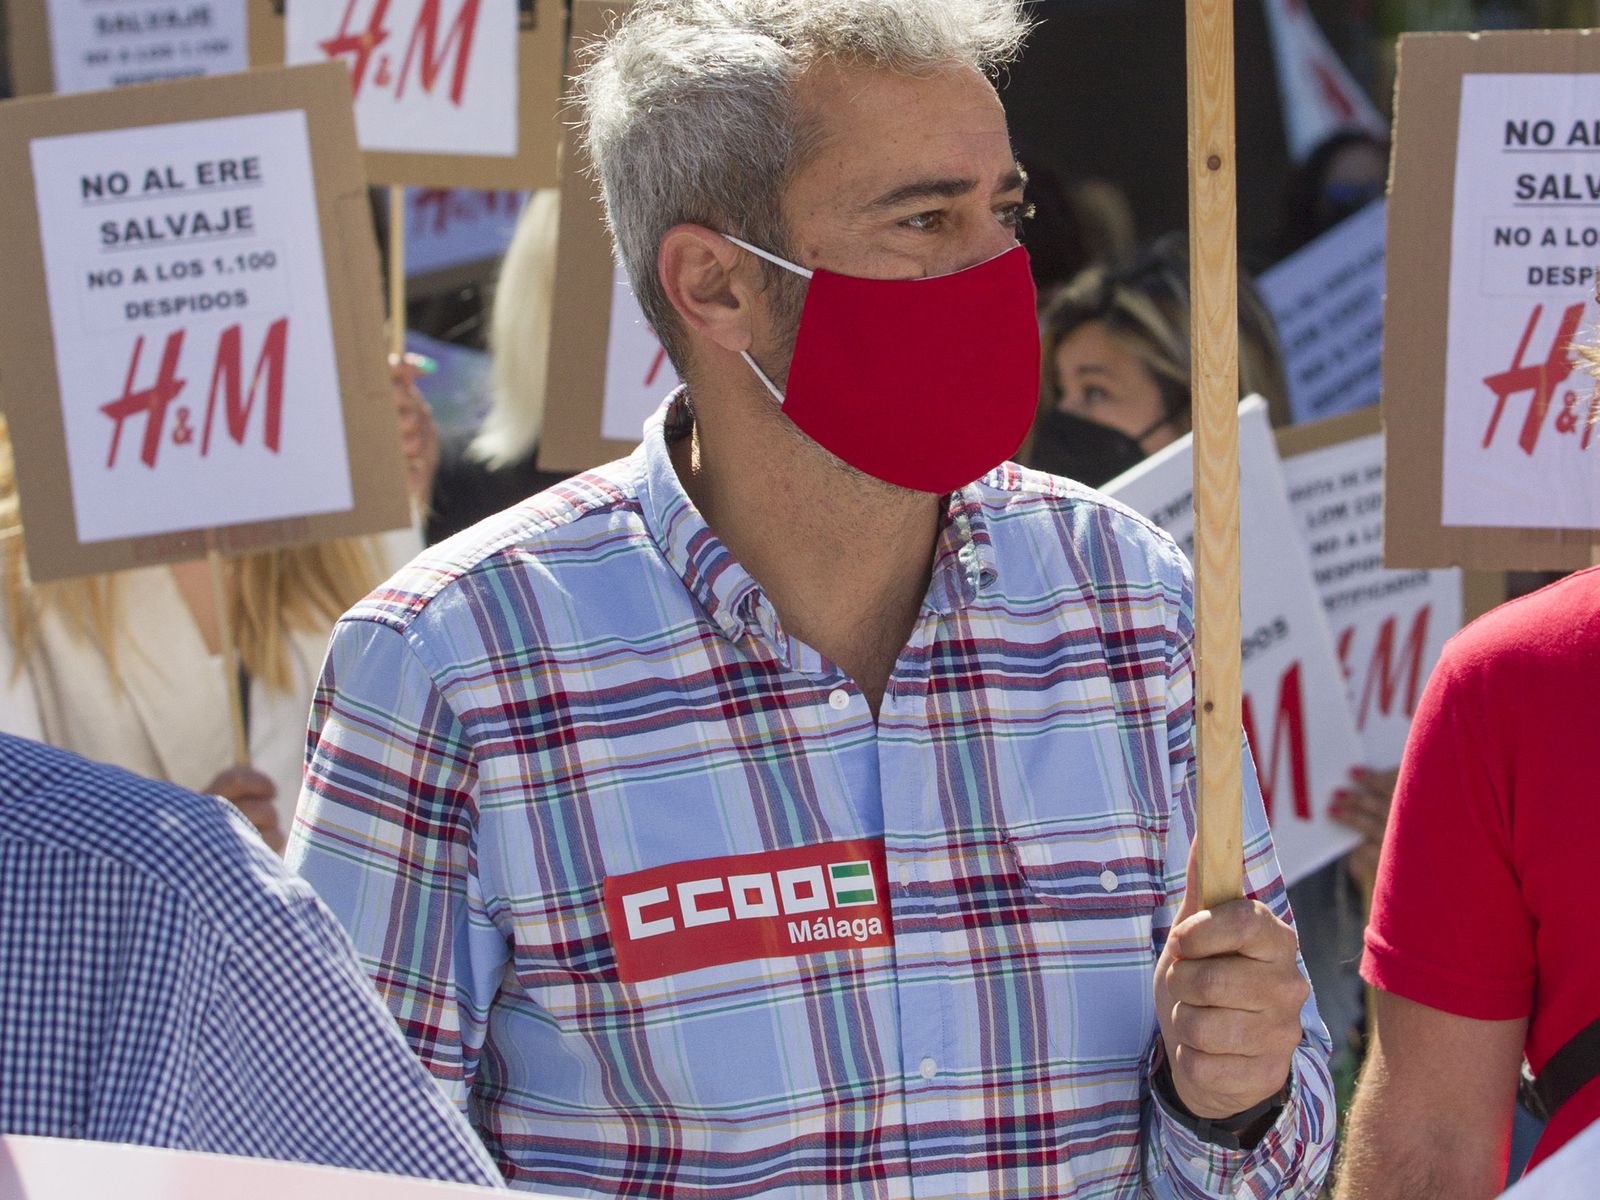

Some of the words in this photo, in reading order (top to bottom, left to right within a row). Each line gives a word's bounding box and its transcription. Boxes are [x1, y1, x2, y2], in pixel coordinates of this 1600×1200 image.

[1505, 119, 1555, 146] NO
[80, 171, 129, 198] NO
[143, 166, 184, 191] AL
[197, 156, 261, 185] ERE
[101, 206, 253, 245] SALVAJE
[1494, 227, 1531, 247] NO
[1540, 227, 1557, 247] A
[1566, 227, 1600, 247] LO
[88, 268, 122, 289] NO
[133, 266, 148, 284] A
[156, 259, 203, 281] LOS
[214, 251, 277, 275] 1.100
[1527, 266, 1593, 286] DESP
[125, 289, 248, 319] DESPIDOS
[99, 316, 289, 471] H&M
[1483, 303, 1600, 456] H&
[787, 916, 883, 944] Málaga
